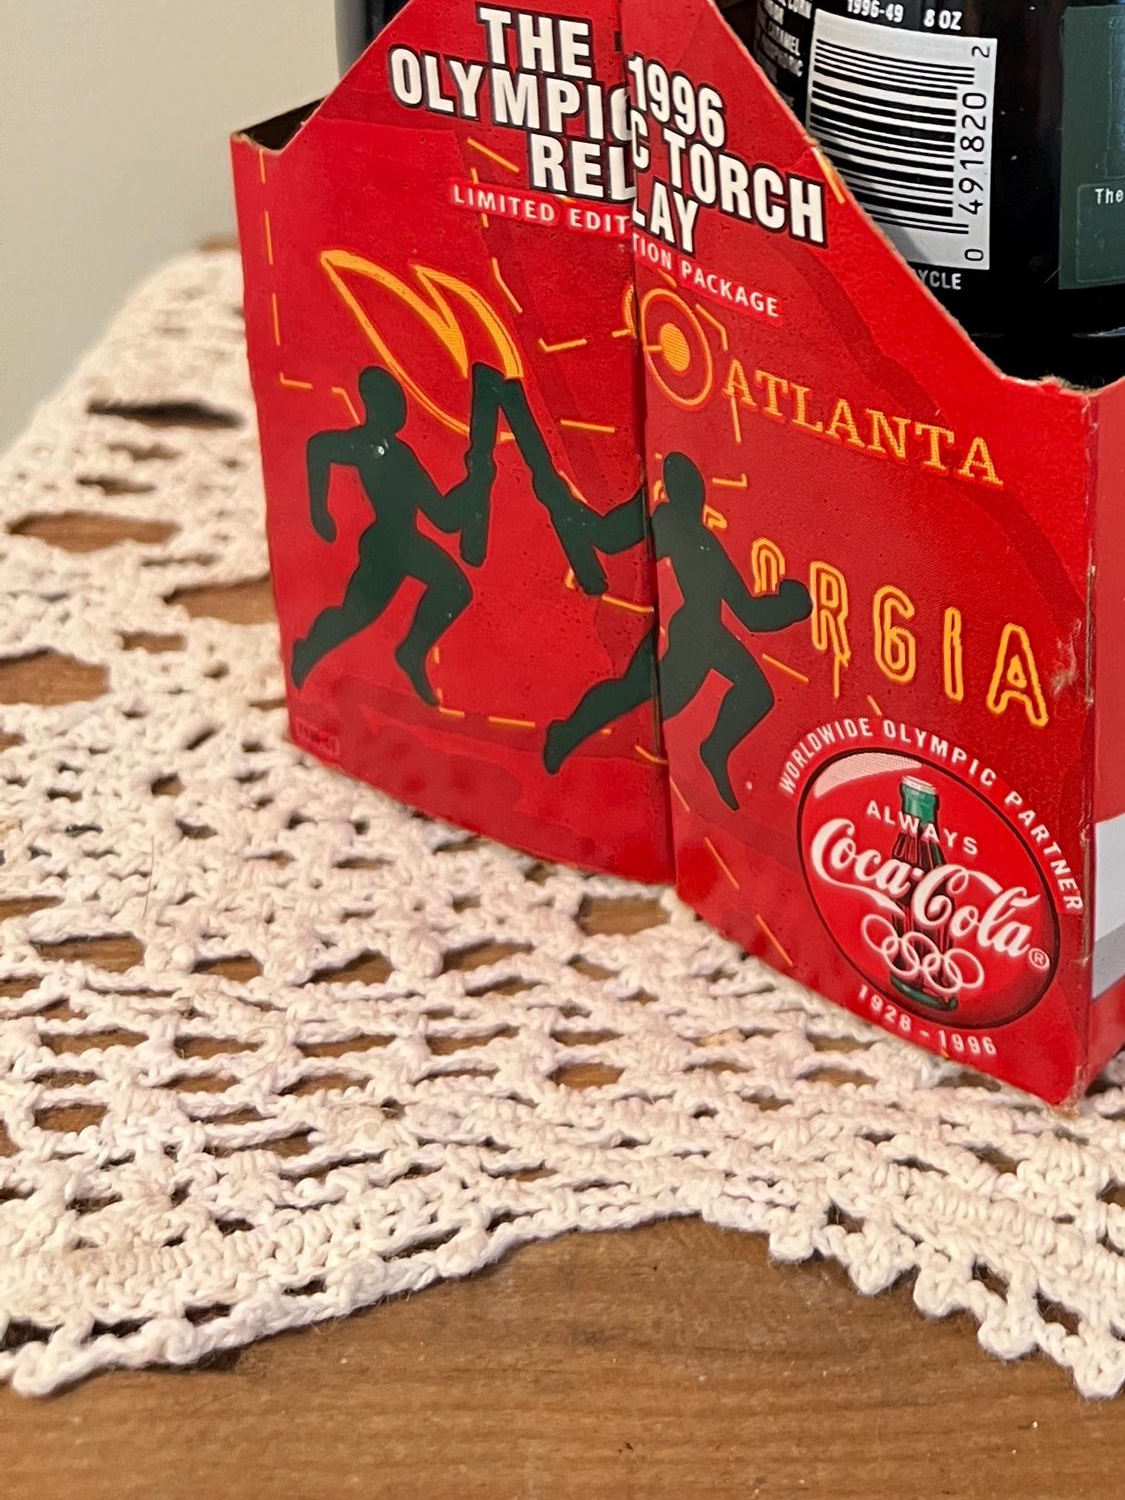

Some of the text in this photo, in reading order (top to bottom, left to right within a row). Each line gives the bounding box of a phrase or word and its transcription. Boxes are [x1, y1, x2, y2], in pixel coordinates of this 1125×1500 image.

[478, 4, 594, 80] THE
[627, 55, 727, 150] 1996
[923, 8, 936, 28] 8
[938, 10, 963, 31] OZ
[388, 46, 827, 245] OLYMPIC TORCH
[958, 45, 991, 262] 0 491820 2
[1095, 187, 1124, 205] The
[452, 183, 557, 223] LIMITED
[681, 258, 780, 319] PACKAGE
[917, 269, 962, 291] YCLE
[723, 357, 1004, 486] ATLANTA
[778, 717, 1084, 911] WORLDWIDE OLYMPIC PARTNER
[866, 799, 979, 856] ALWAYS
[858, 984, 914, 1032] 1928
[937, 1028, 998, 1056] 1996
